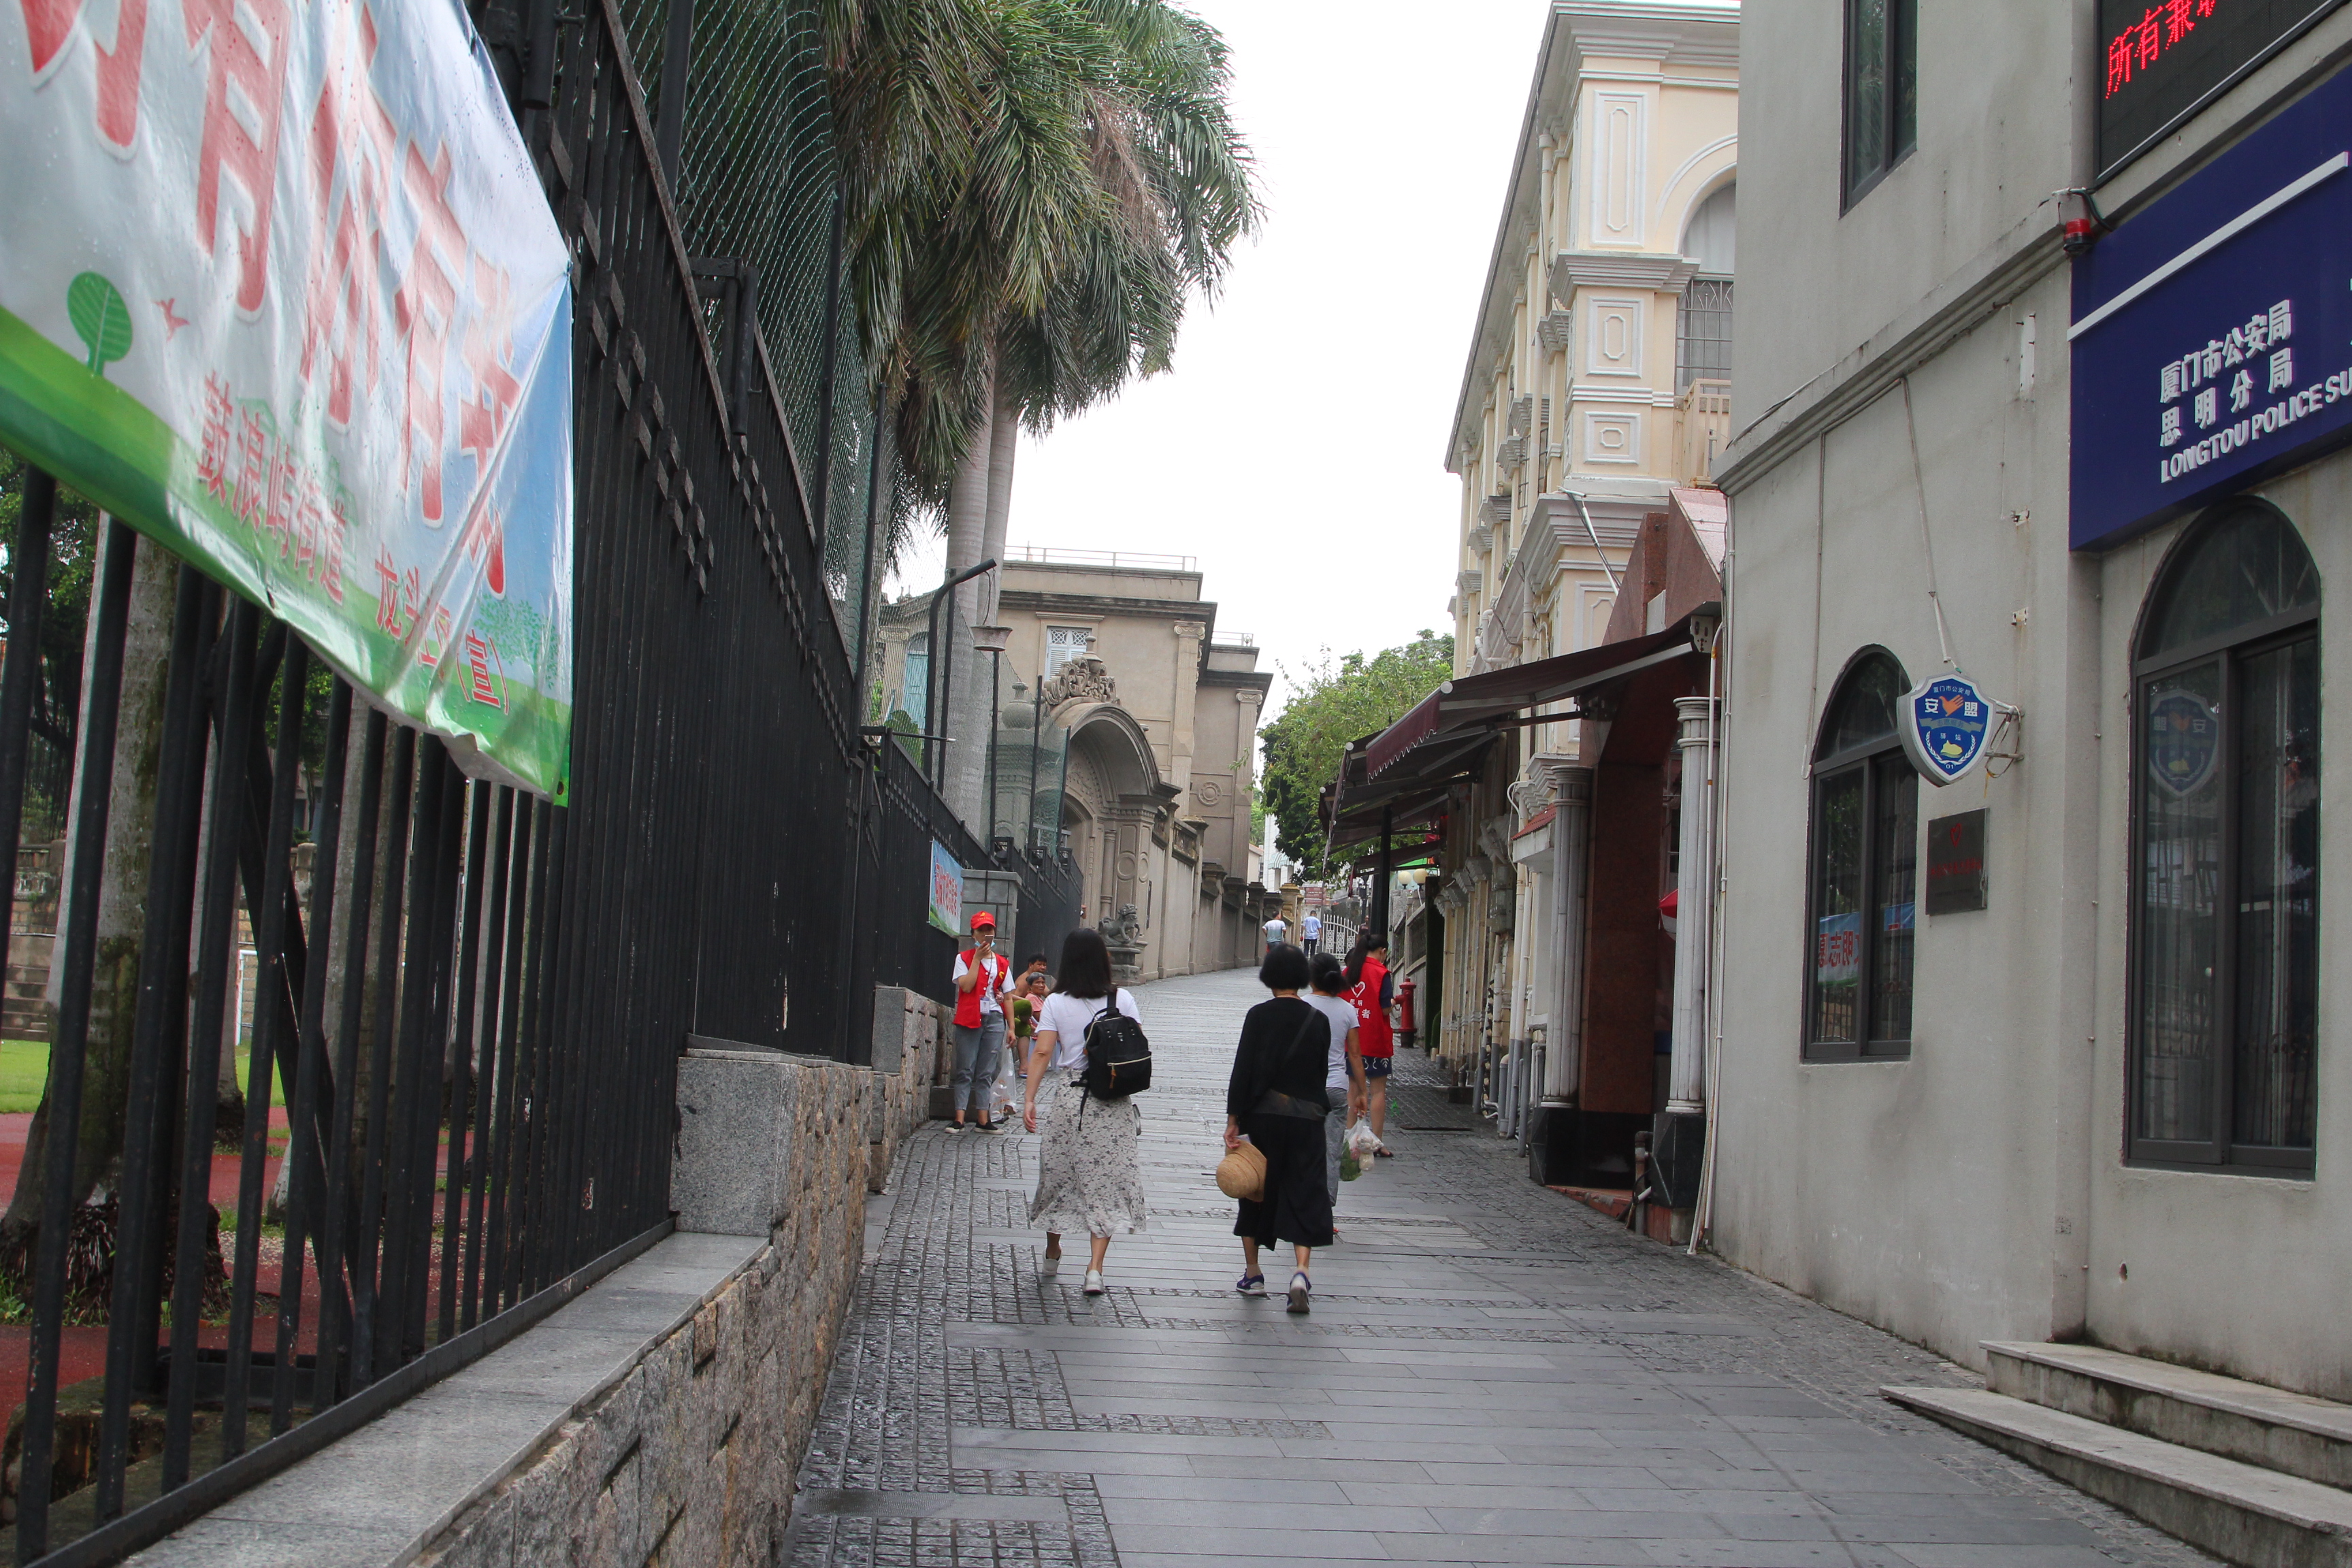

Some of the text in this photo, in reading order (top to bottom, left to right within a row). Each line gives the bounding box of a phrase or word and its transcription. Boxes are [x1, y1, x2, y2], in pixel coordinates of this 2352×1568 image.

[2160, 299, 2291, 403] 厦门市公安局
[2160, 348, 2292, 446] 思明分局
[2161, 419, 2249, 484] LONGTOU
[2251, 383, 2323, 440] POLICE
[197, 370, 344, 606] 鼓浪屿街道
[1933, 685, 1971, 696] 厦门市公安局
